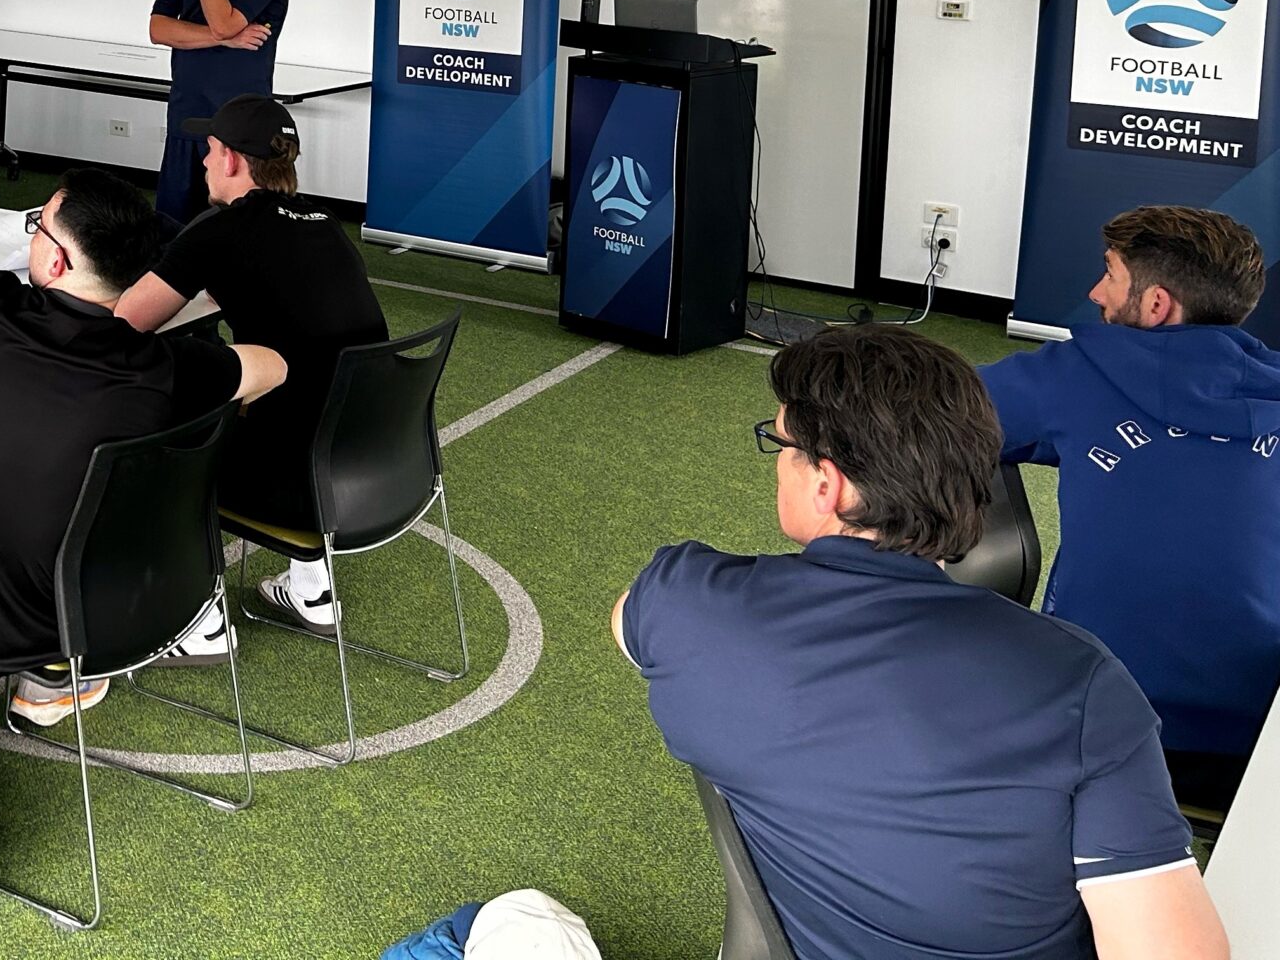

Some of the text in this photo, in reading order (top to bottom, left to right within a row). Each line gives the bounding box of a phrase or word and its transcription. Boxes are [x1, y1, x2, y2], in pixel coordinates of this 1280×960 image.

[424, 7, 498, 25] FOOTBALL
[441, 22, 480, 38] NSW
[433, 53, 485, 70] COACH
[1110, 56, 1223, 81] FOOTBALL
[405, 65, 513, 88] DEVELOPMENT
[1135, 76, 1195, 97] NSW
[1121, 114, 1201, 136] COACH
[1079, 127, 1244, 159] DEVELOPMENT
[593, 226, 646, 248] FOOTBALL
[604, 239, 633, 256] NSW
